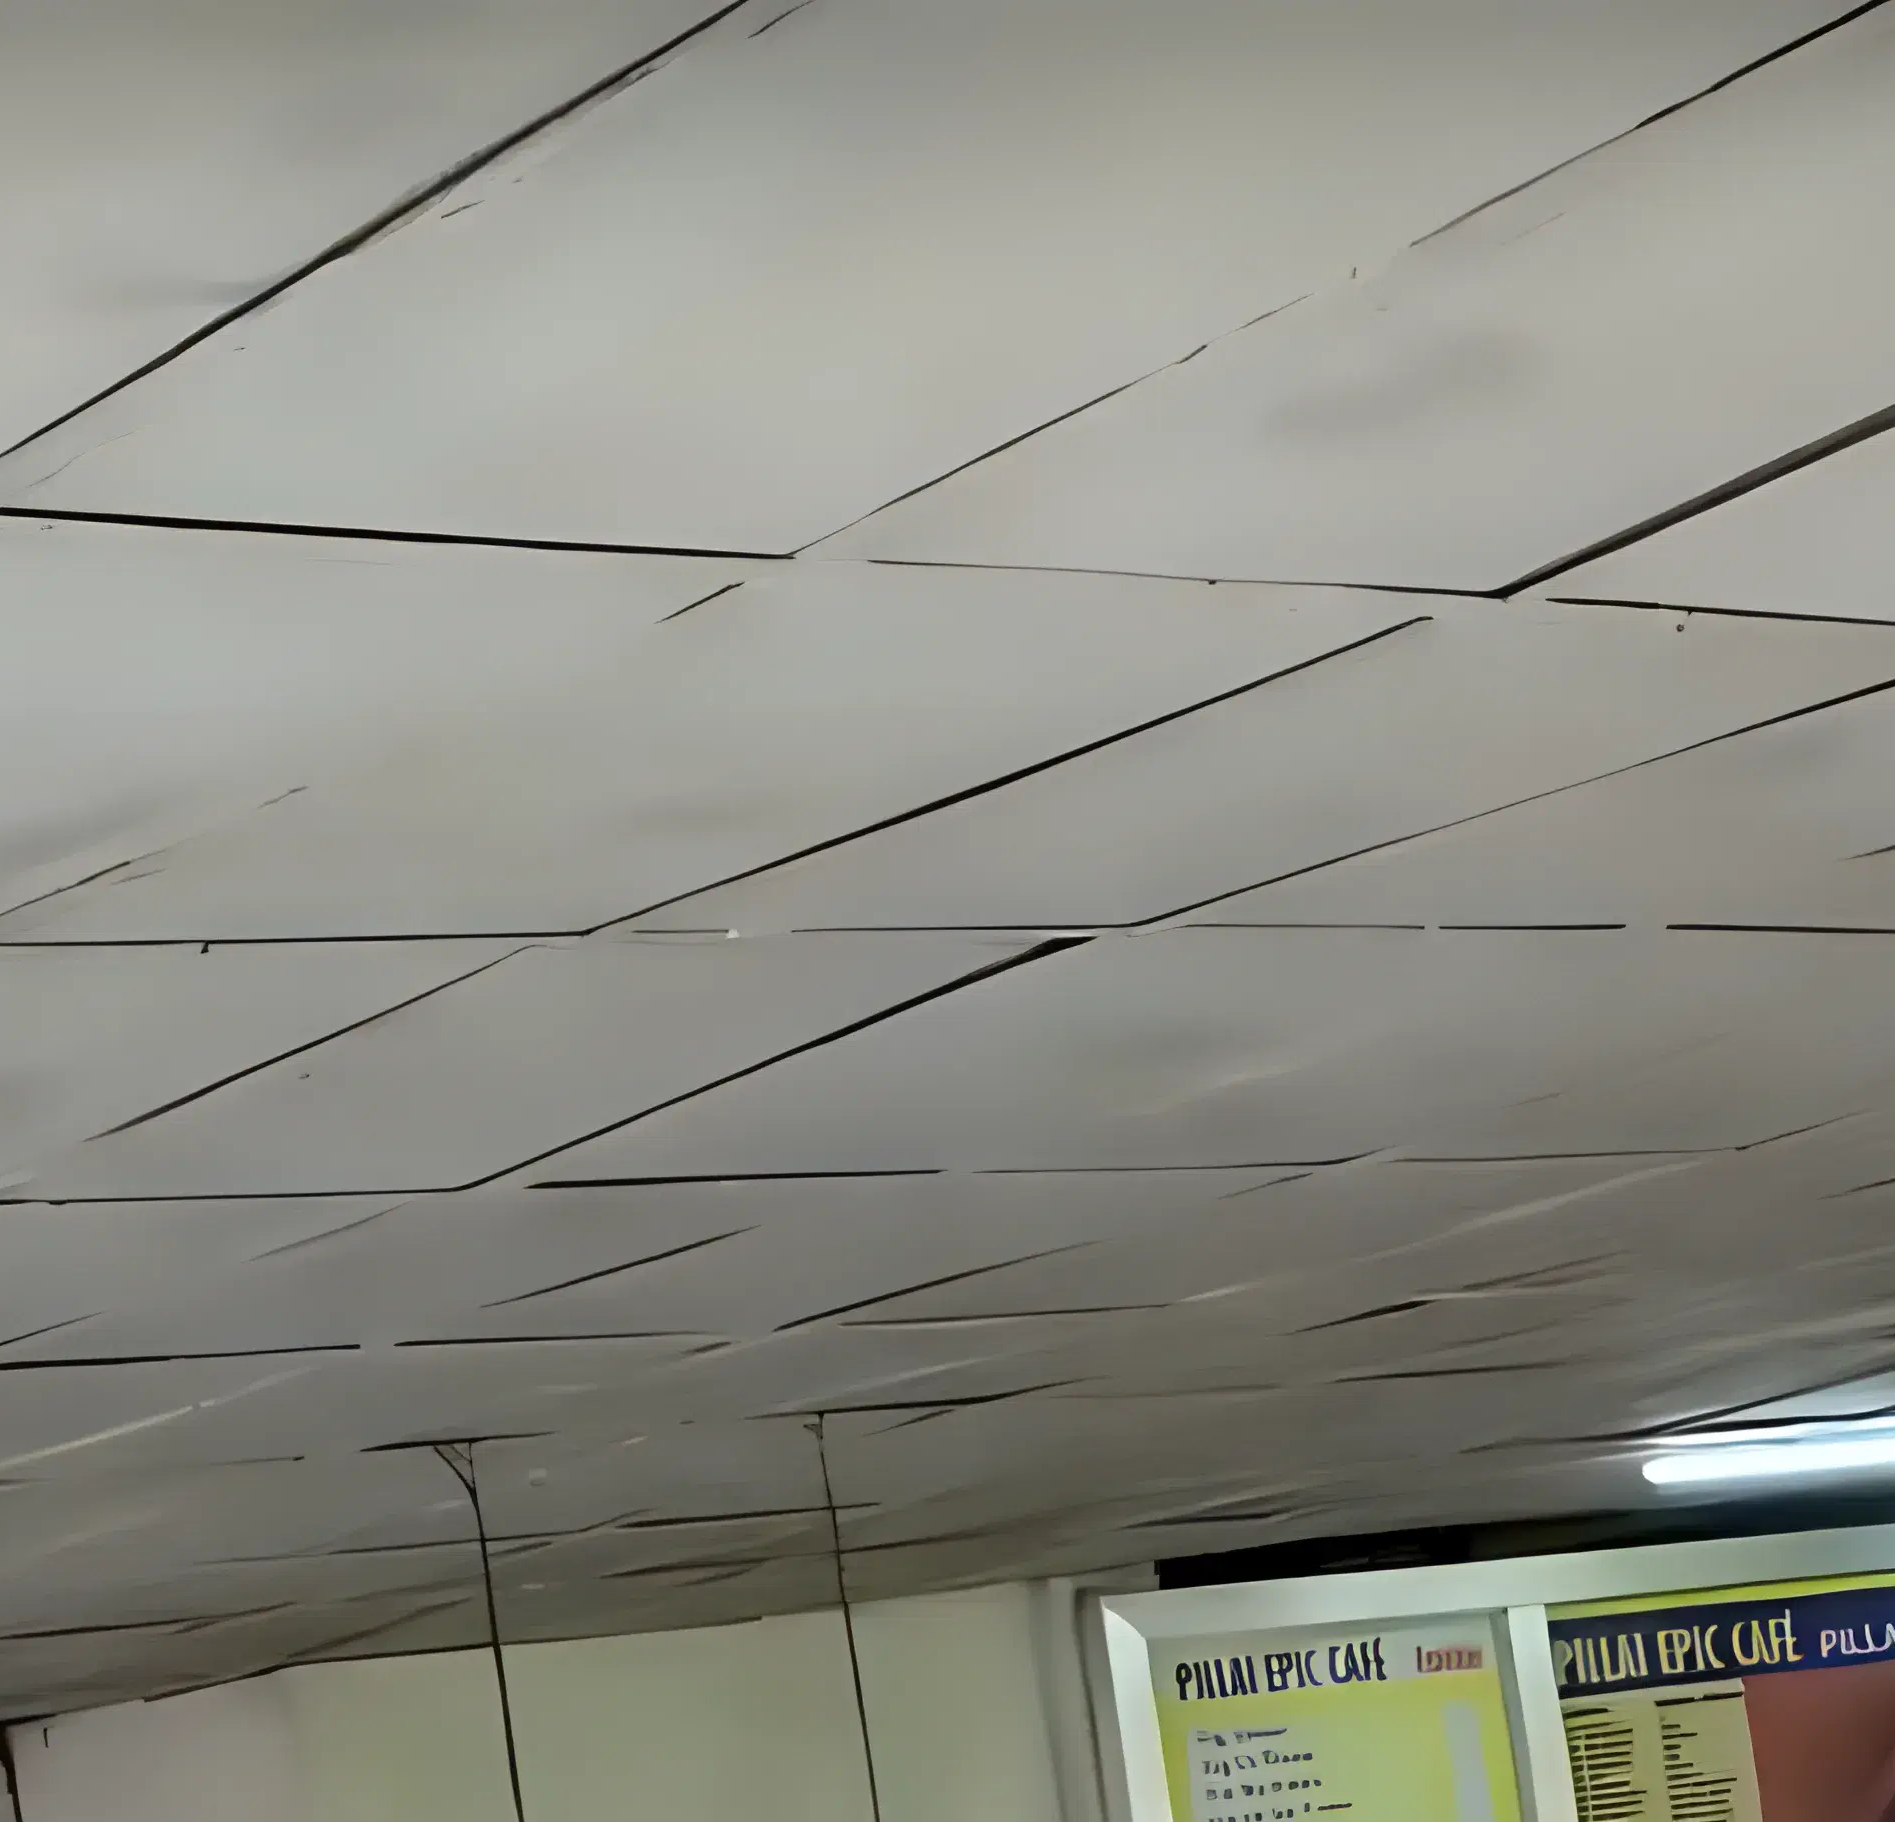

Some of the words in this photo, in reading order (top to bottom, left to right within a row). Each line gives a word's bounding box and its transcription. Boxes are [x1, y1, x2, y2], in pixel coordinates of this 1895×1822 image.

[1264, 1648, 1324, 1693] EPIC
[1553, 1632, 1648, 1685] PILLAI
[1657, 1625, 1726, 1675] EPIC
